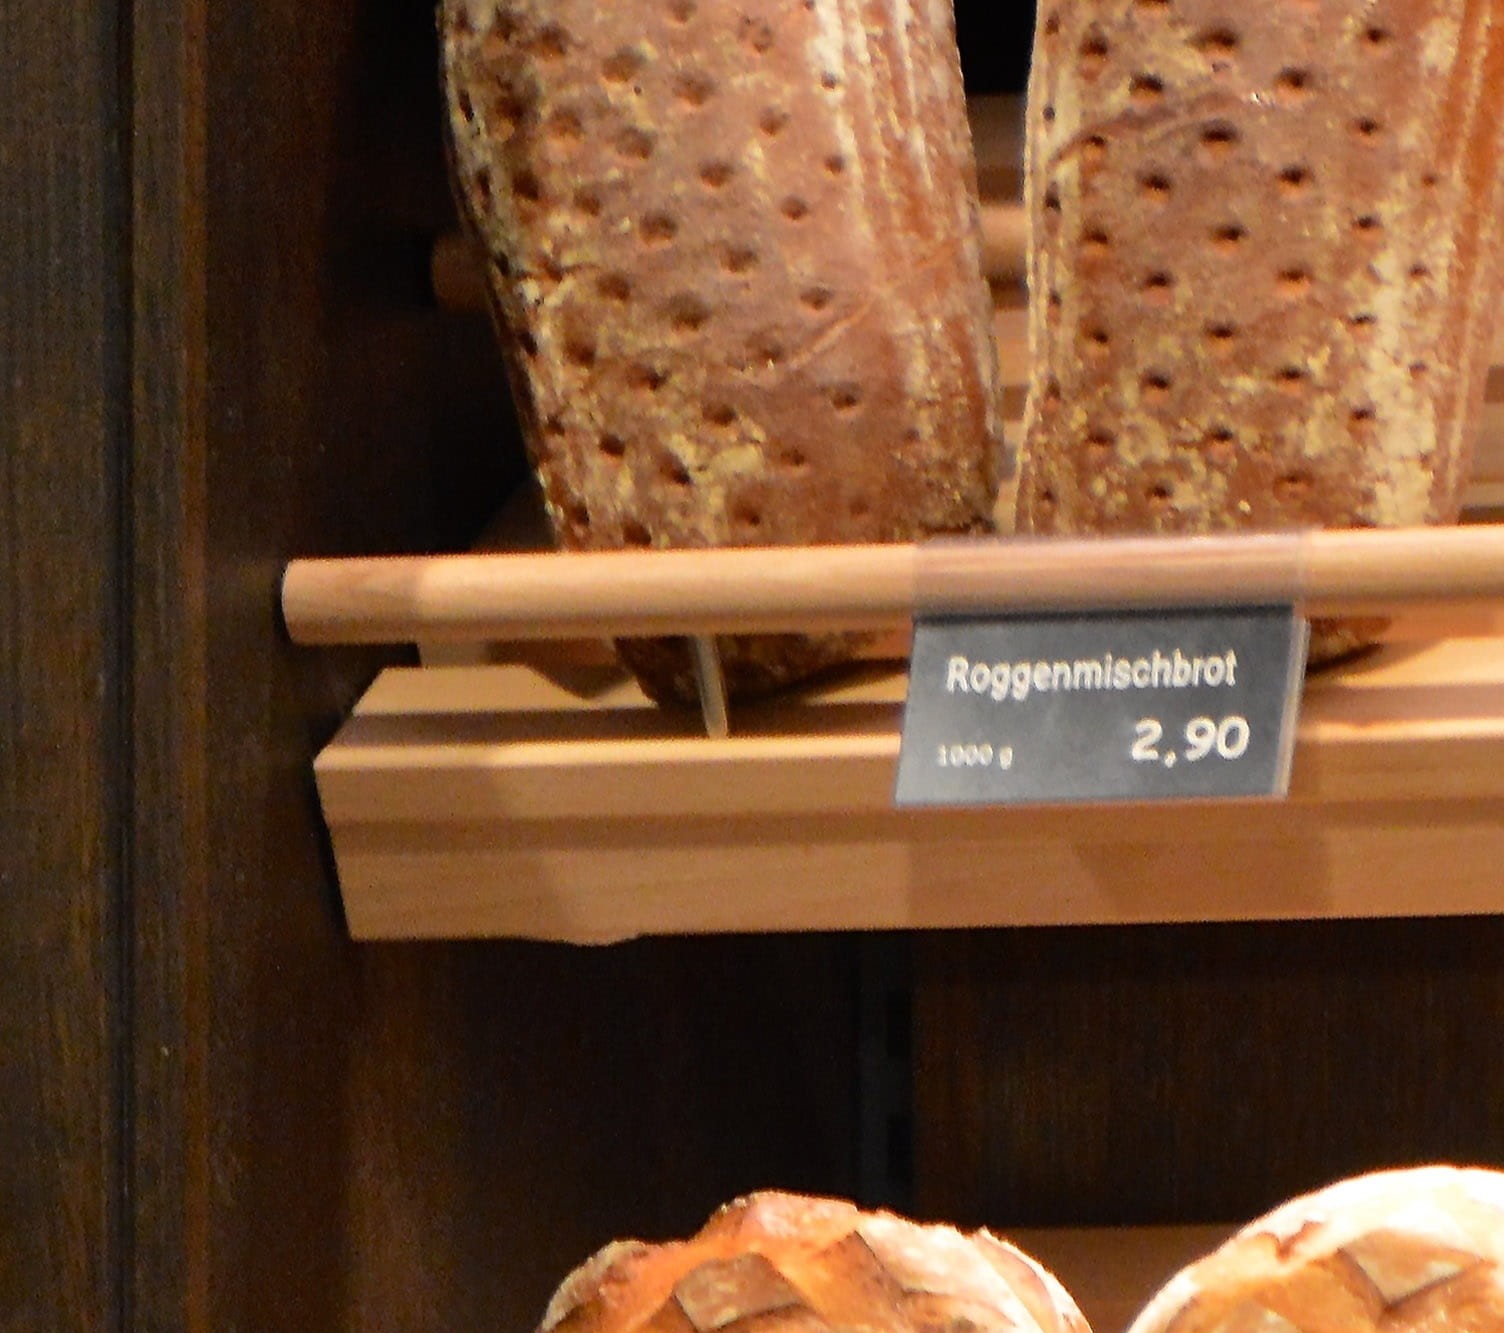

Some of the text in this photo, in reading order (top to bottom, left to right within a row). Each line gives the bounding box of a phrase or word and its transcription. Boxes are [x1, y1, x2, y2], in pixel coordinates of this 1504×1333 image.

[946, 649, 1238, 701] Roggenmischbrot
[937, 715, 1251, 771] 1000 g 2,90
